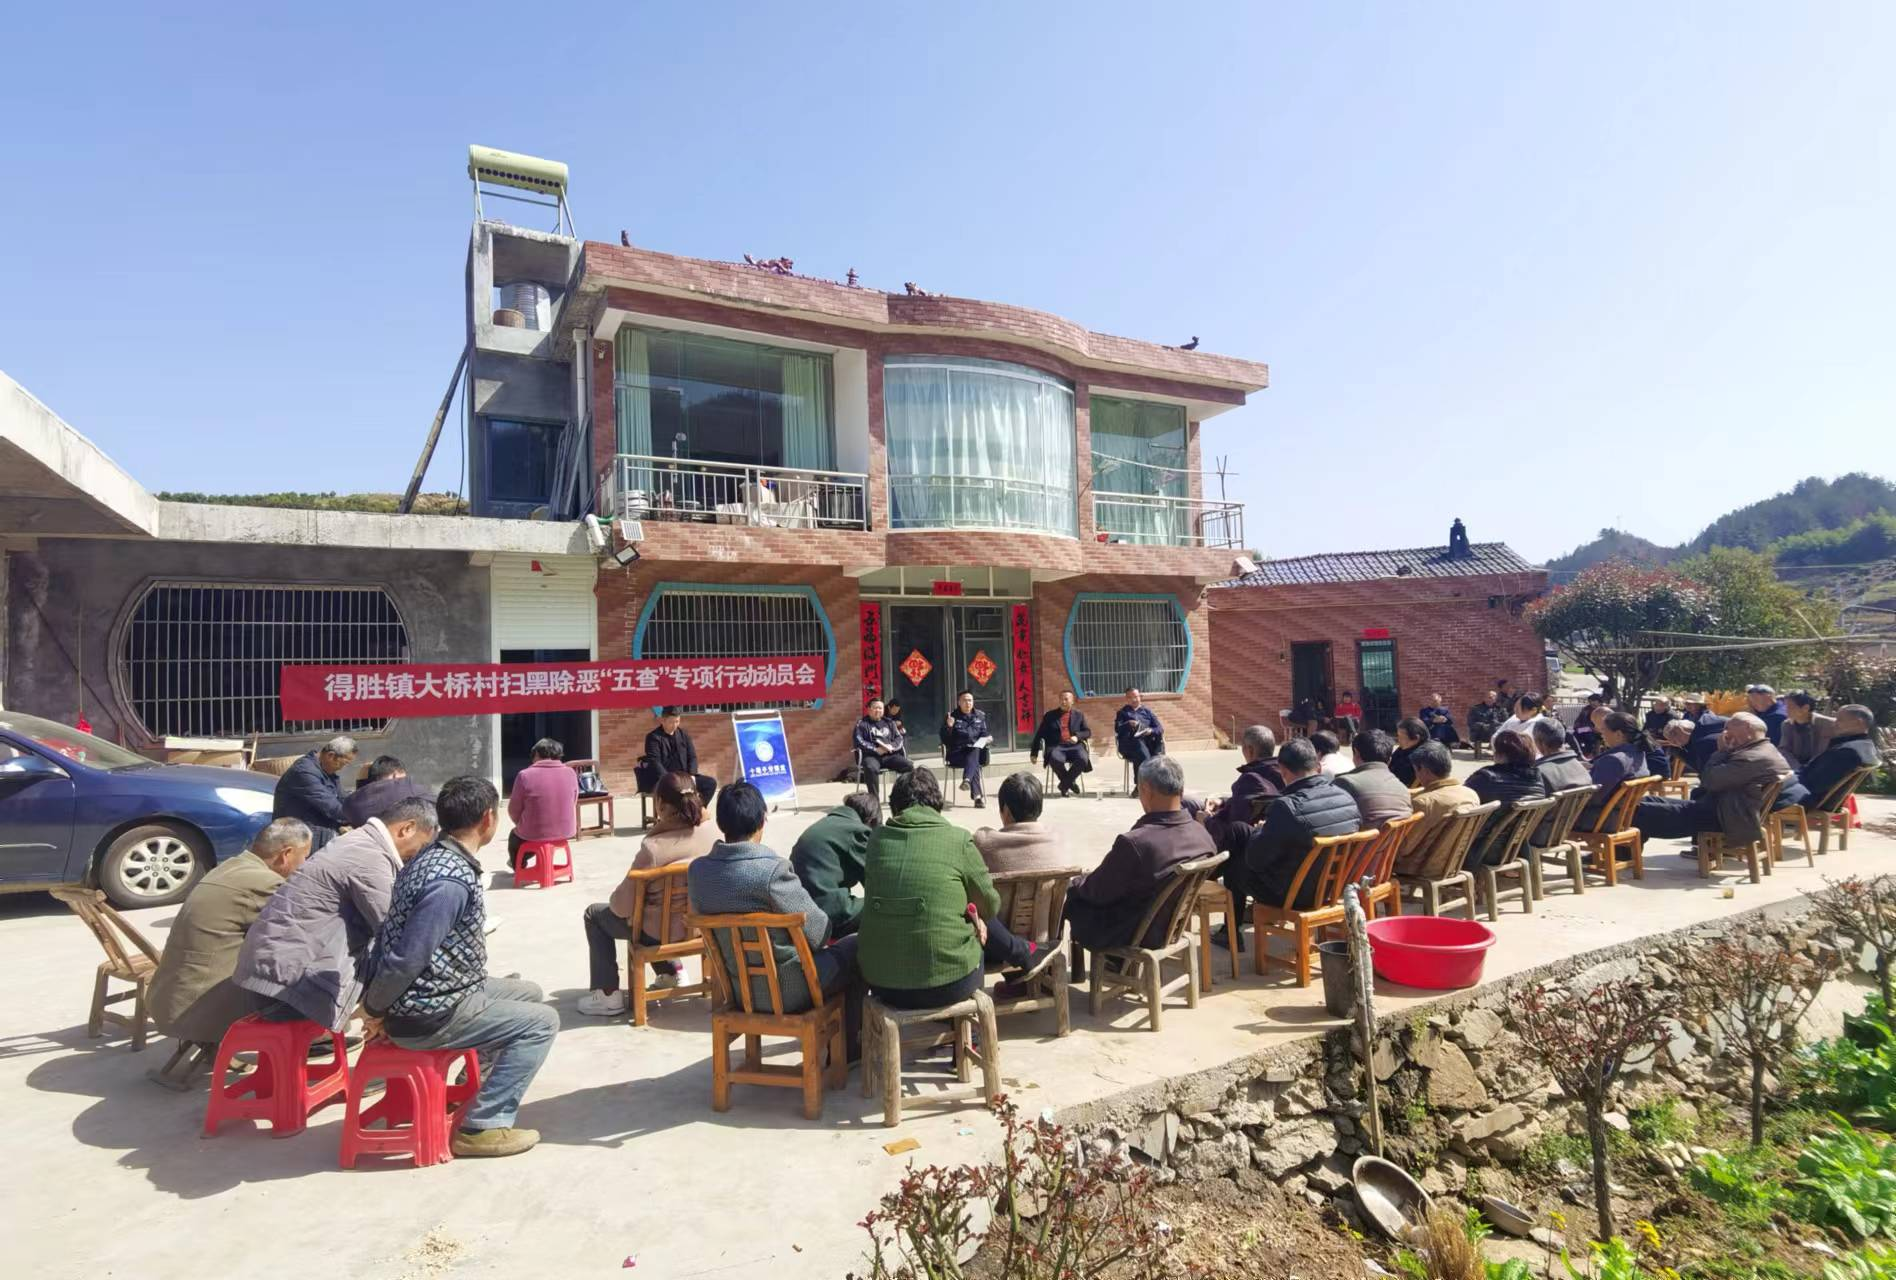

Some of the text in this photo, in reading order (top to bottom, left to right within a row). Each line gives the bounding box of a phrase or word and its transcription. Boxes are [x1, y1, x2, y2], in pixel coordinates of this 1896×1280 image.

[324, 663, 815, 701] 得胜镇大桥村扫黑除恶“五查”专项行动动员会
